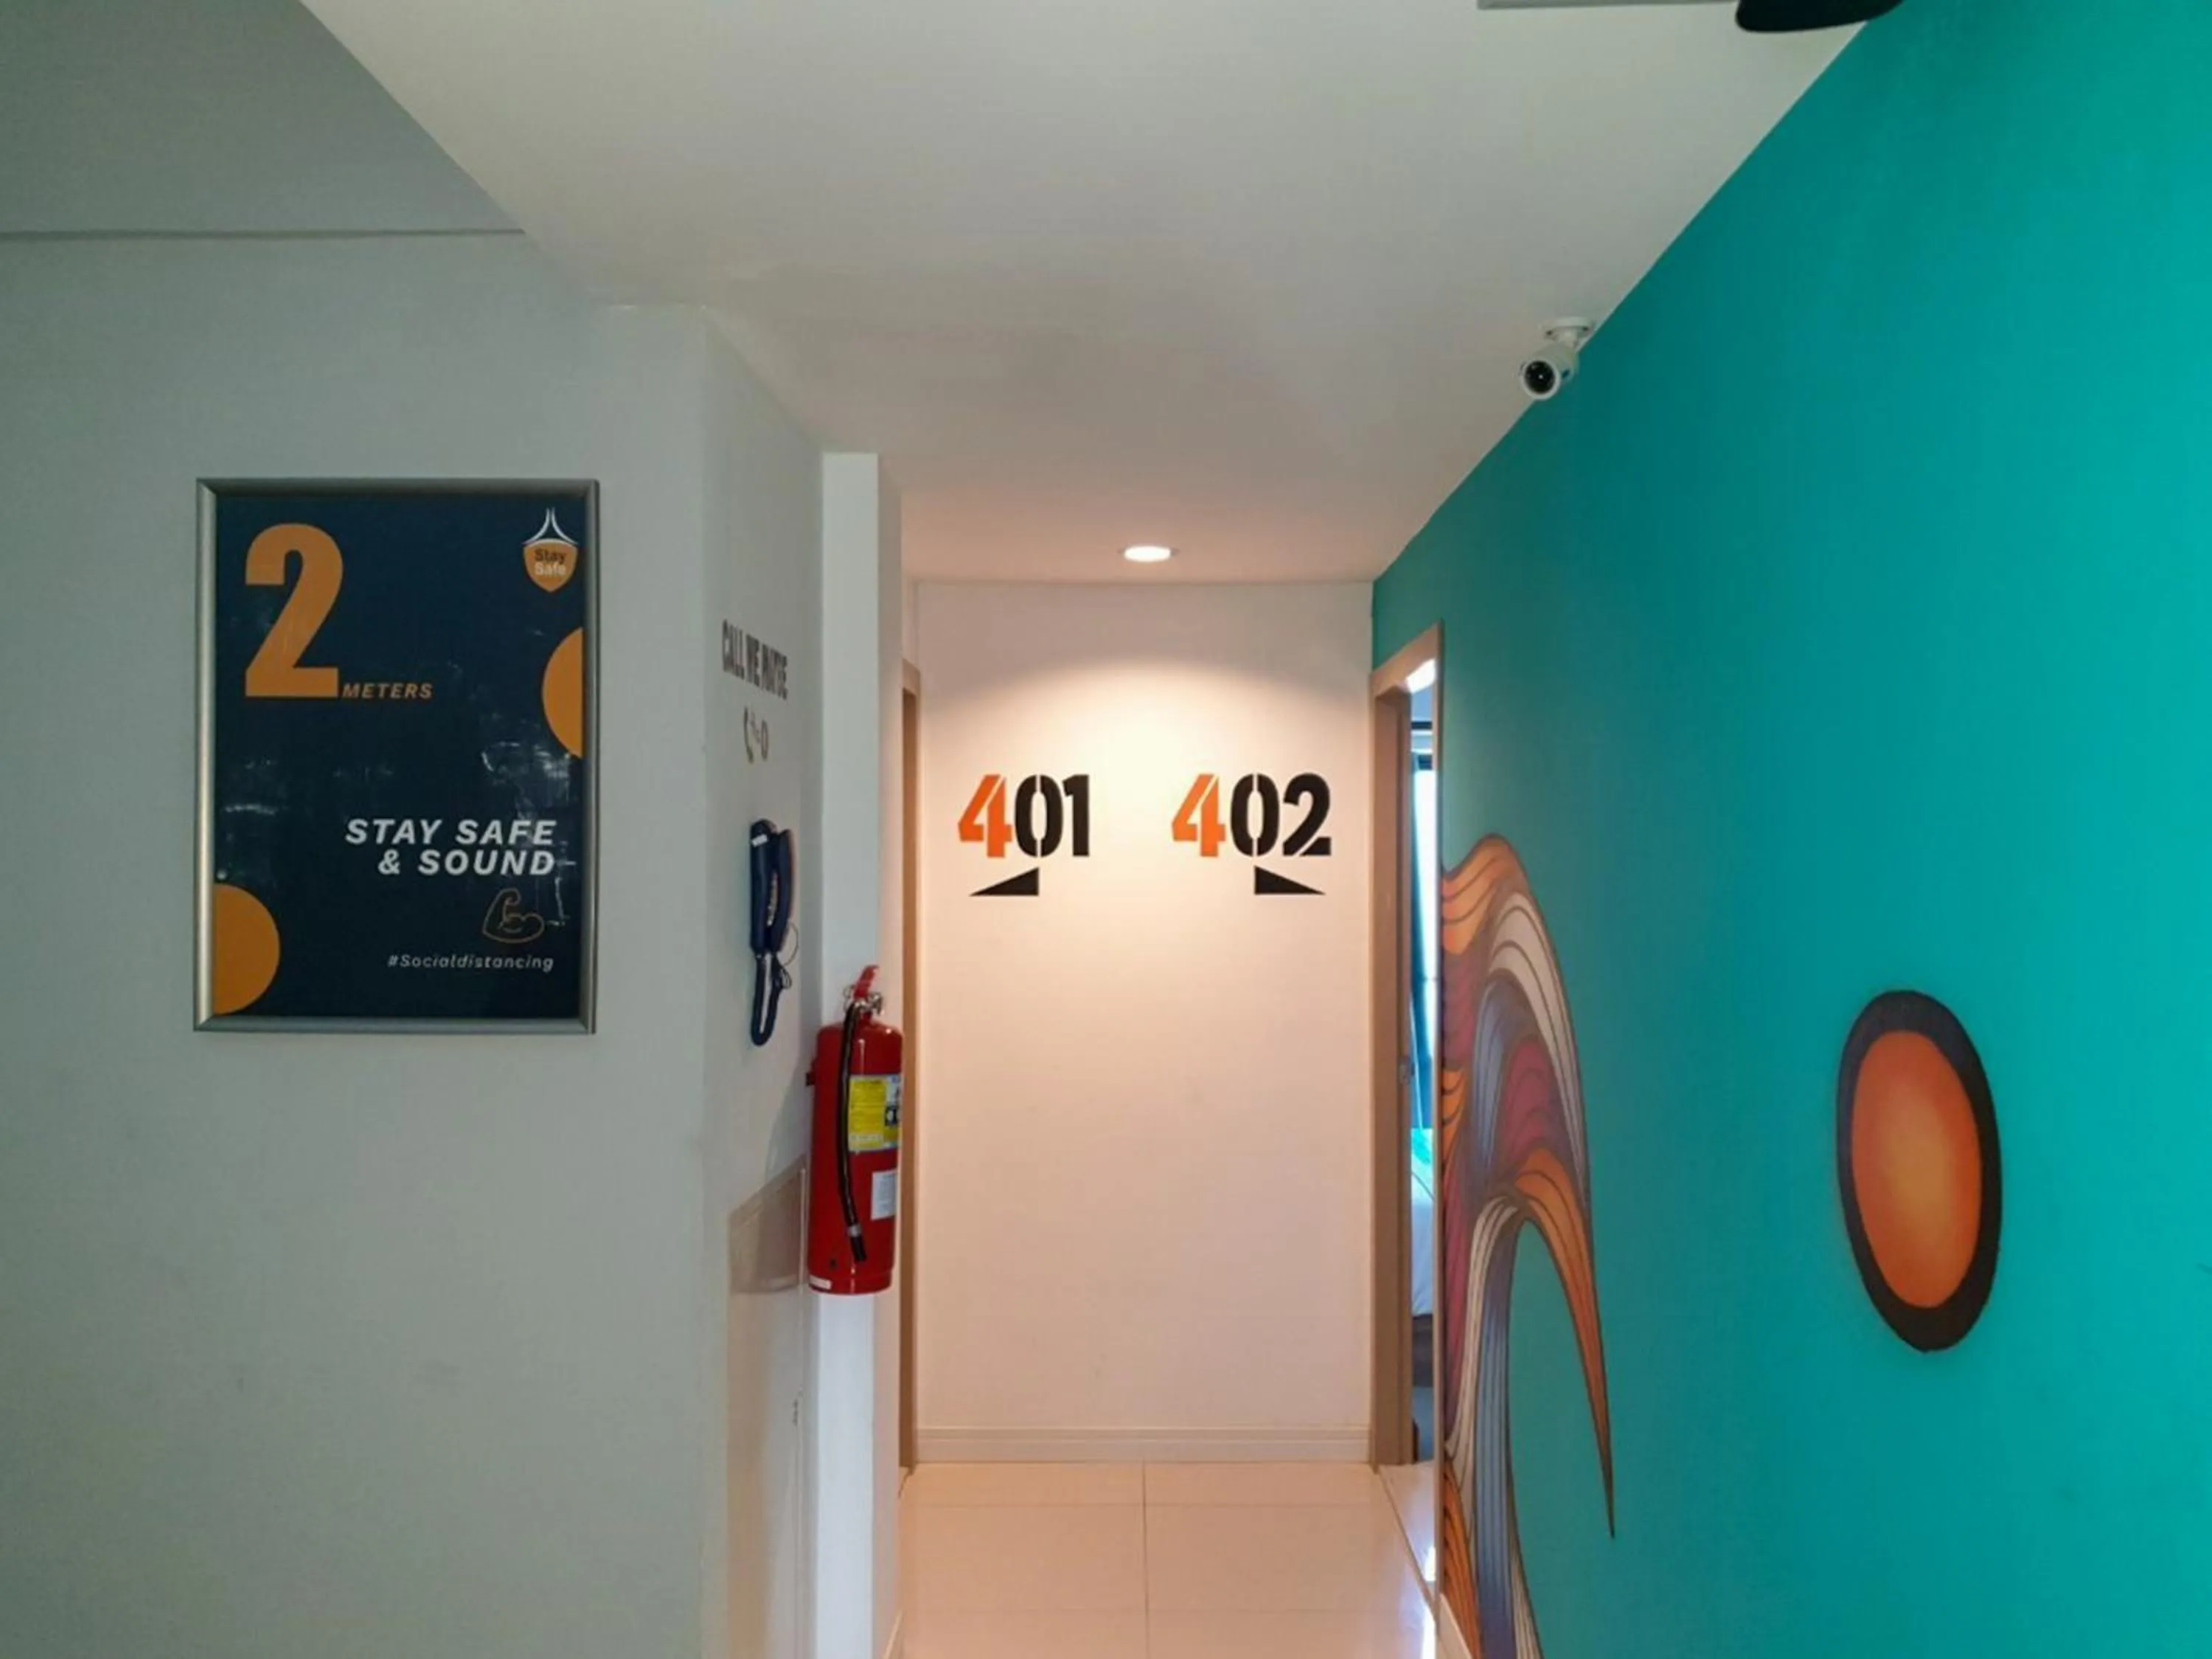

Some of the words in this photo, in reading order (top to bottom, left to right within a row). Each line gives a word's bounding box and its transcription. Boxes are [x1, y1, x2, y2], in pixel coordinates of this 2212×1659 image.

[534, 549, 566, 565] Stay
[534, 562, 566, 576] Safe
[245, 523, 344, 698] 2
[341, 683, 434, 699] METERS
[722, 619, 745, 681] CALL
[745, 633, 760, 687] ME
[958, 774, 1090, 858] 401
[1172, 773, 1332, 858] 402
[345, 818, 442, 845] STAY
[455, 818, 557, 846] SAFE
[378, 849, 400, 875] &
[417, 849, 554, 876] SOUND
[388, 954, 554, 973] #Socialdistancing
